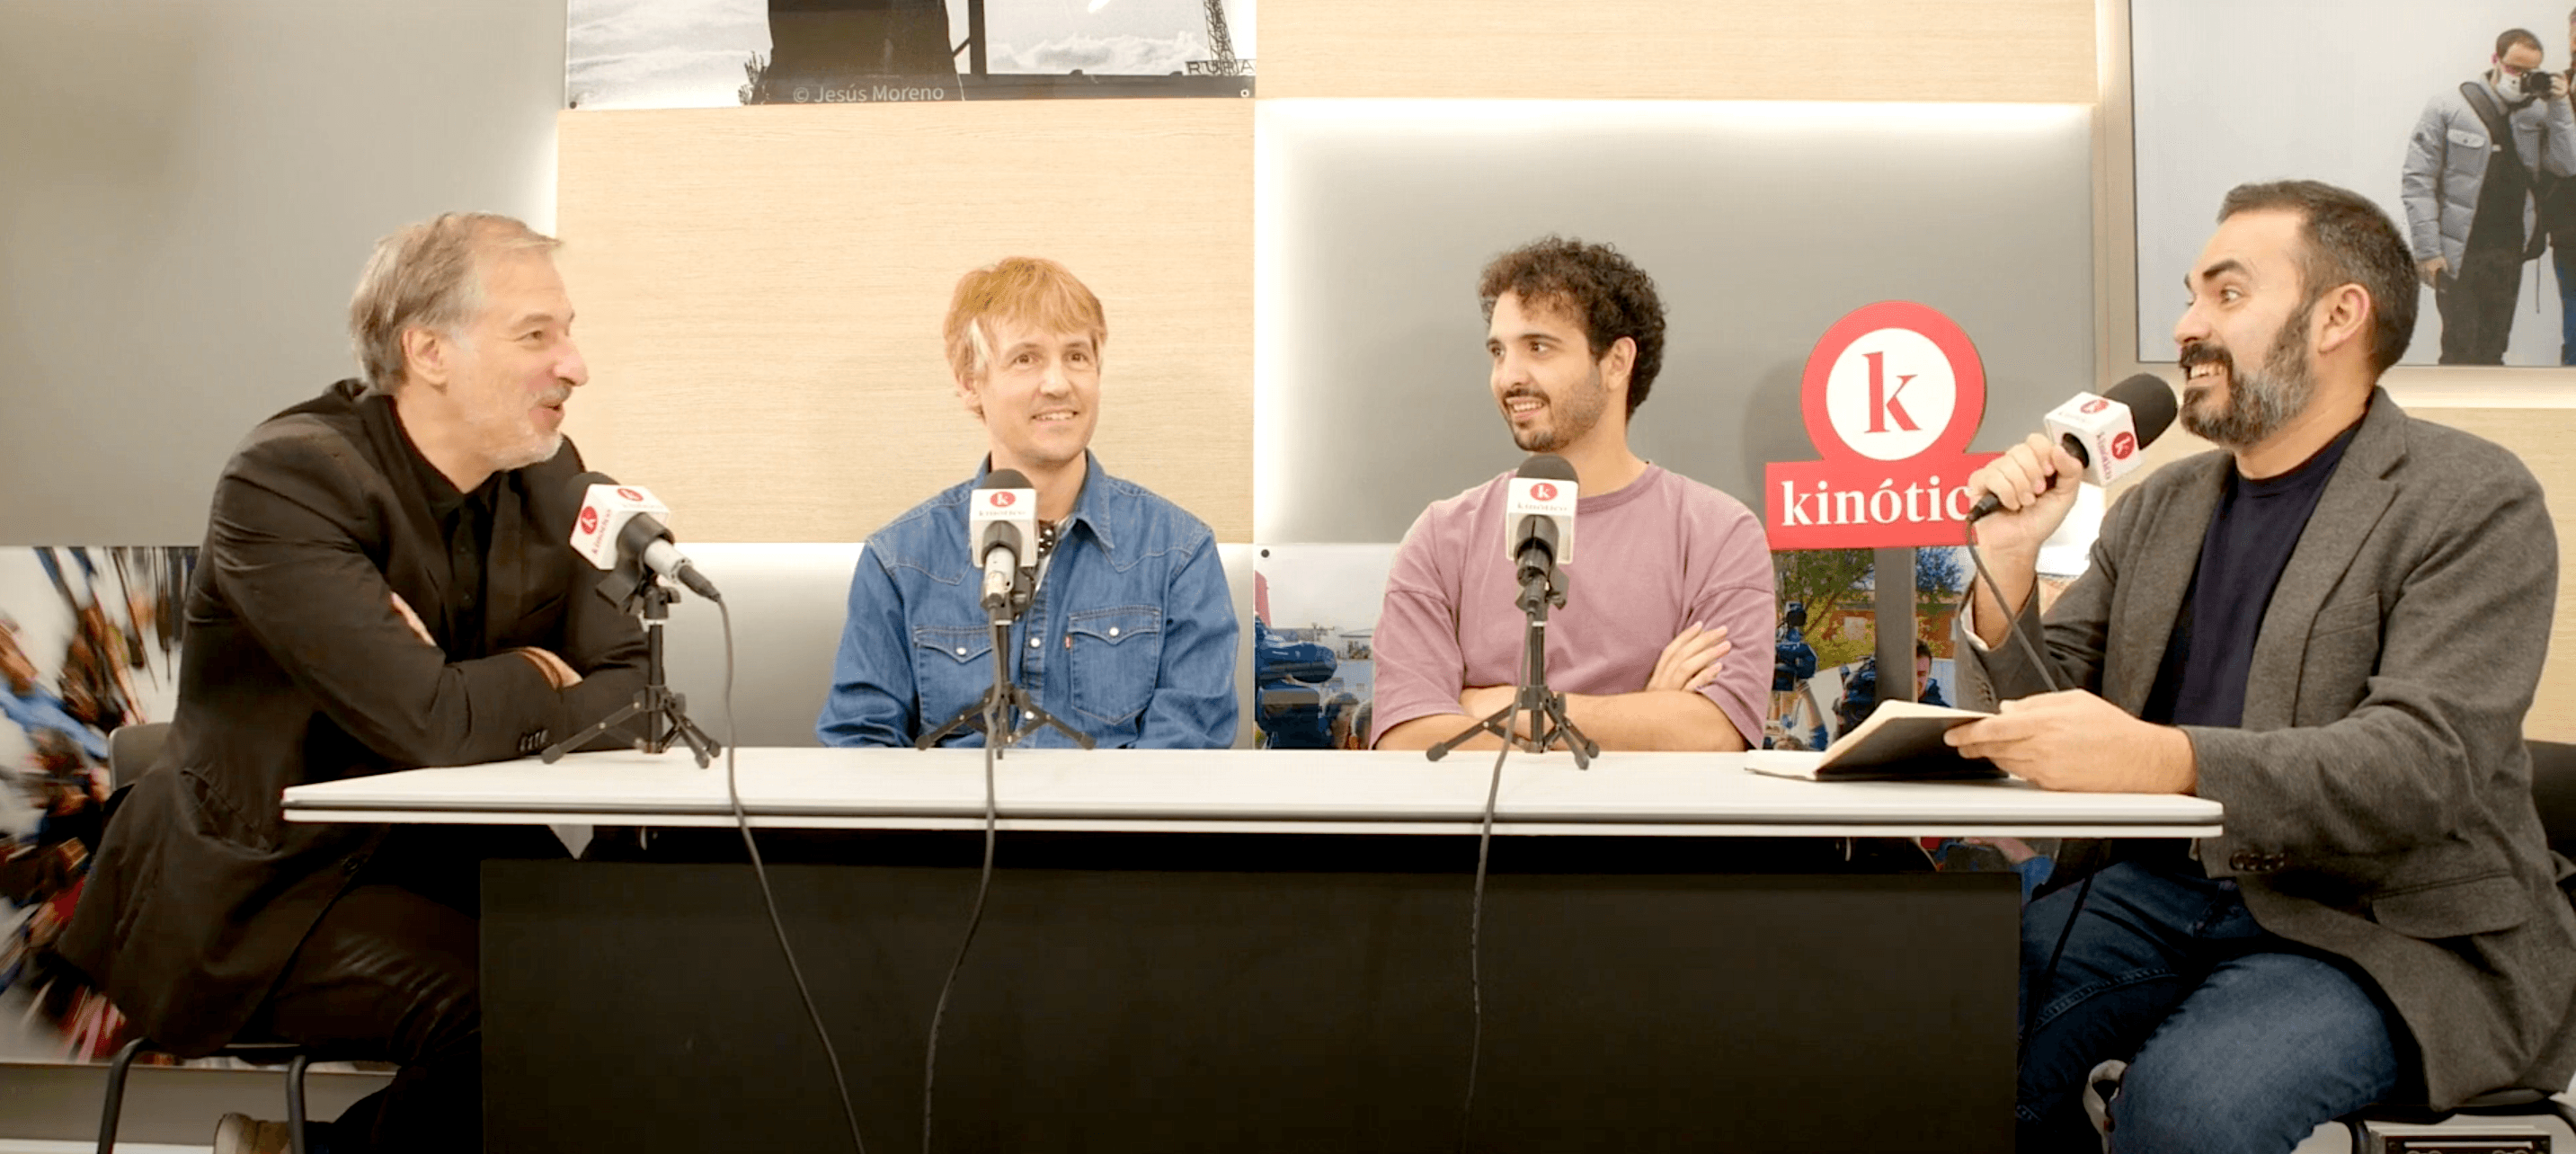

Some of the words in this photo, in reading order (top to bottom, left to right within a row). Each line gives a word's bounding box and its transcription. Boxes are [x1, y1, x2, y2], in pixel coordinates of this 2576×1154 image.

[793, 86, 809, 102] ©
[814, 84, 867, 102] Jesús
[872, 84, 944, 102] Moreno
[1862, 351, 1920, 433] k
[997, 493, 1009, 506] k
[1537, 485, 1551, 500] k
[1781, 475, 1973, 527] kinótic
